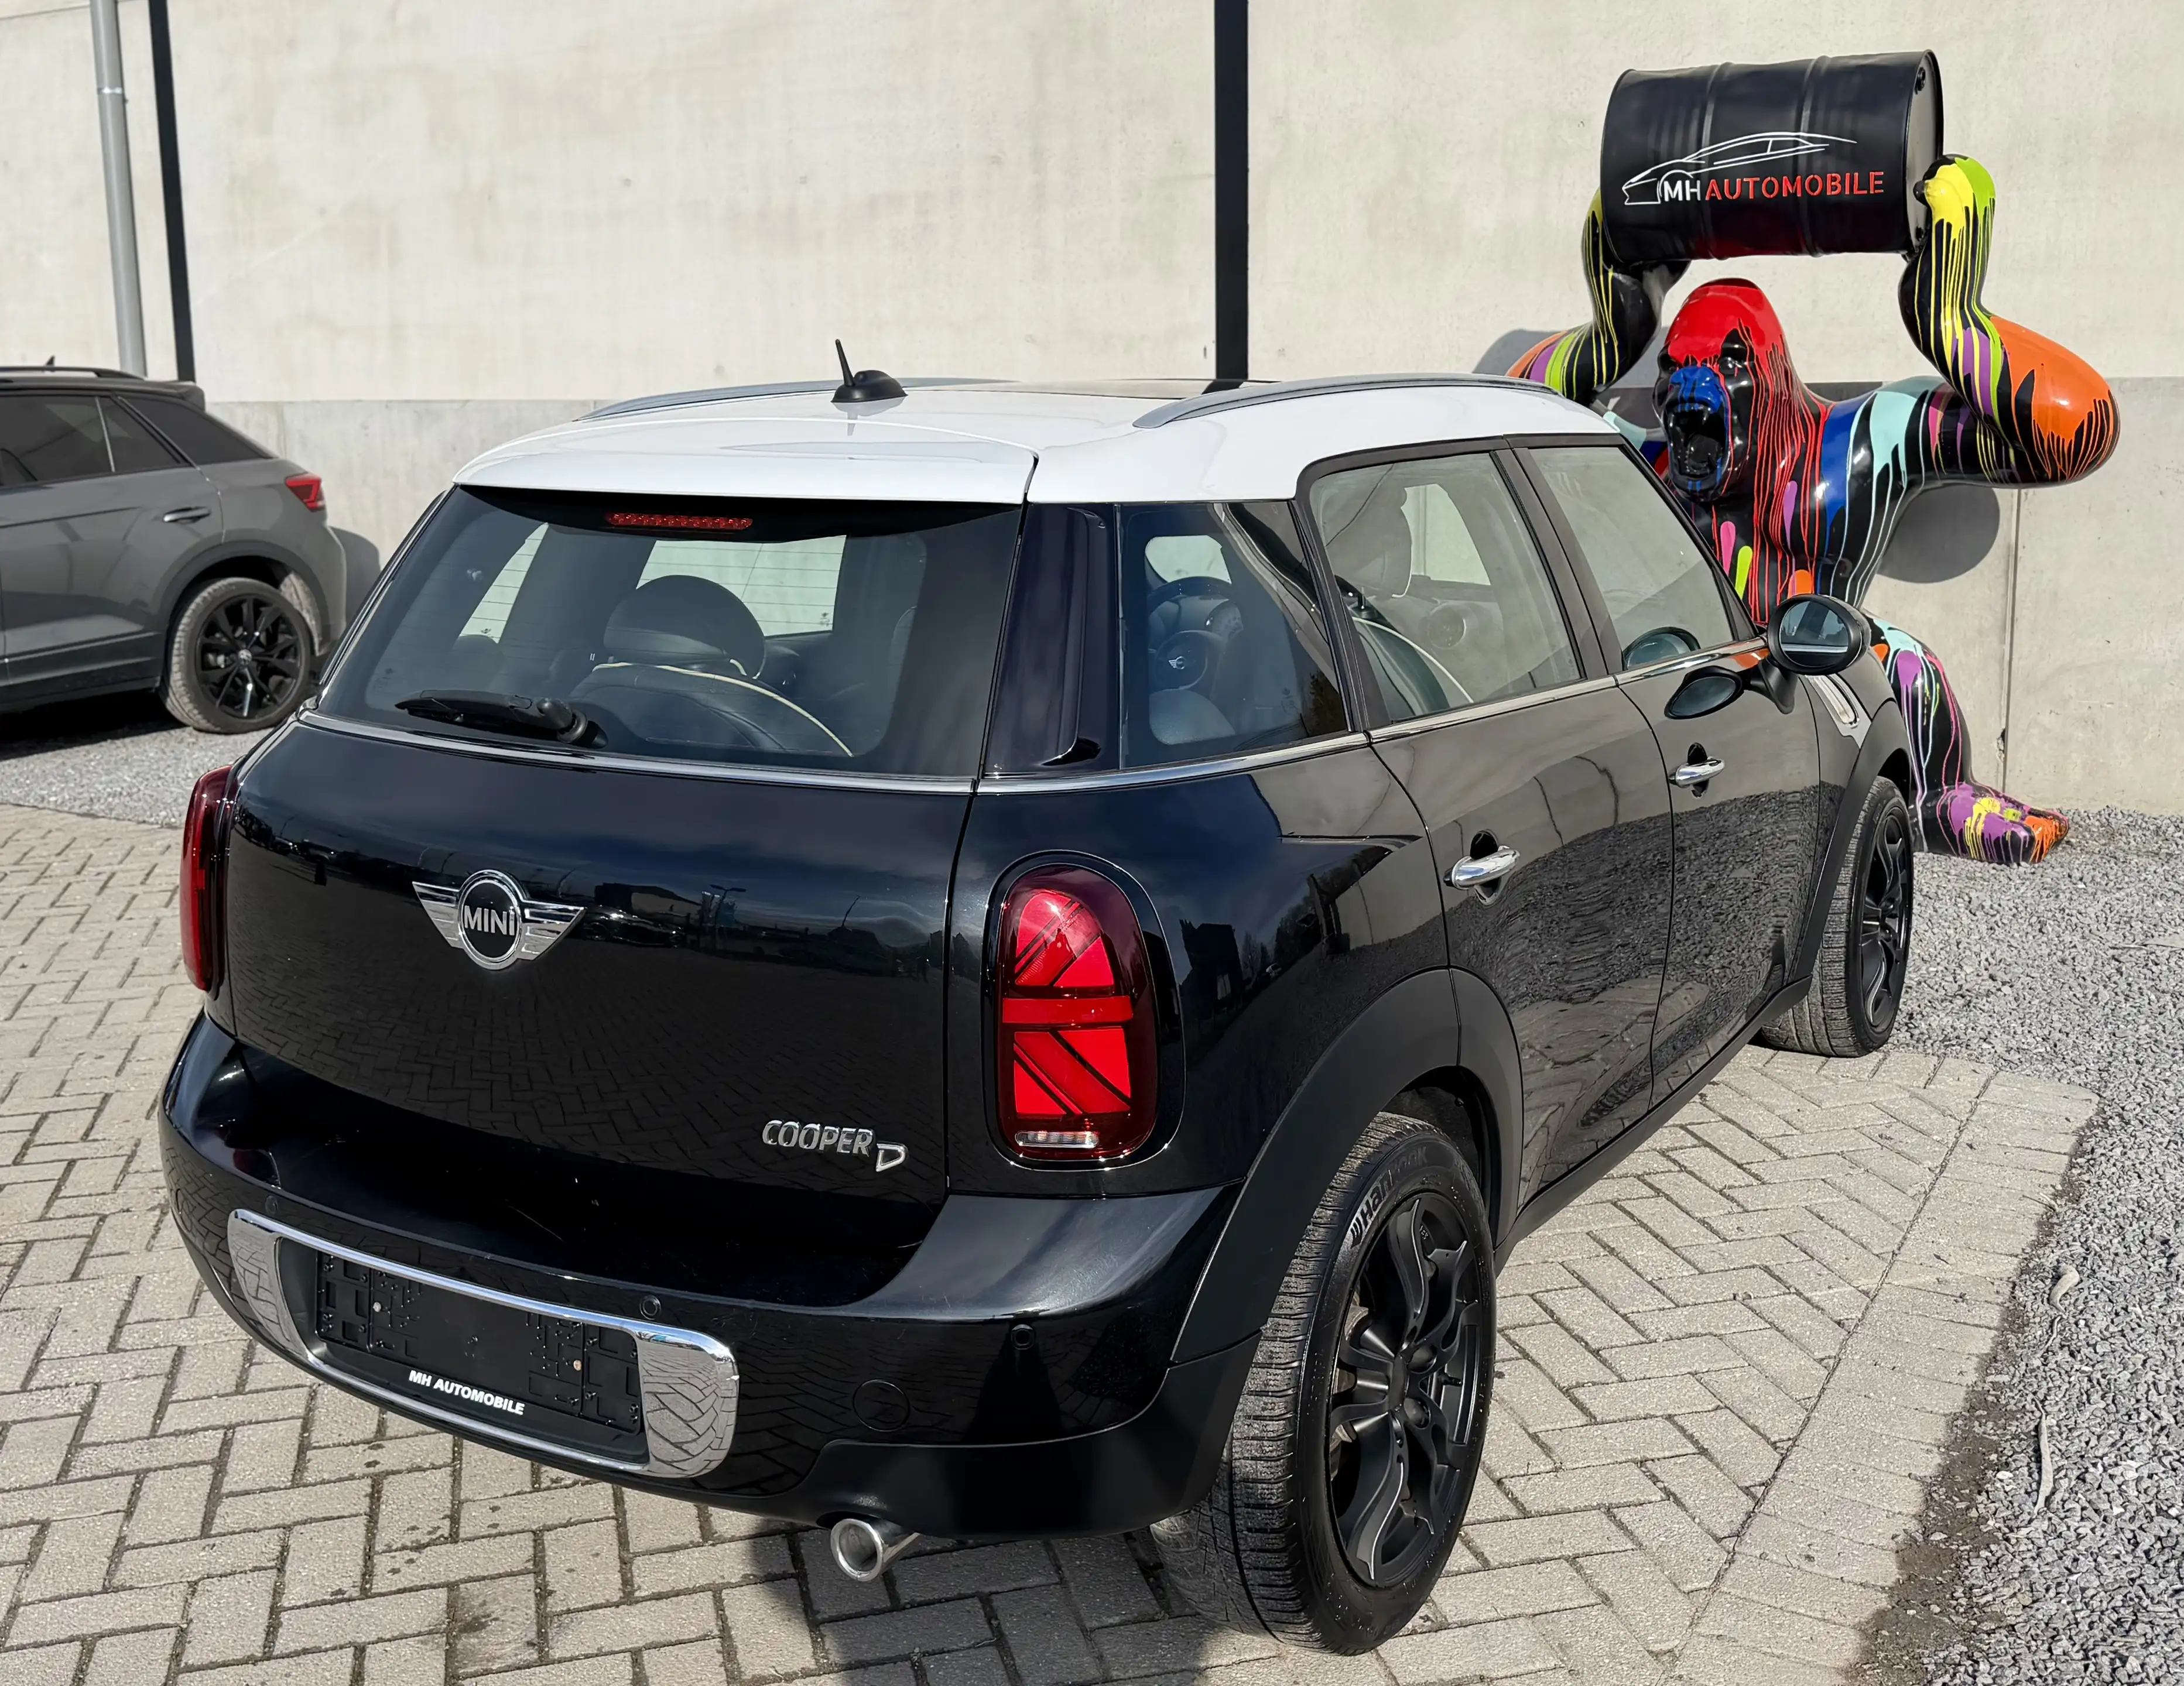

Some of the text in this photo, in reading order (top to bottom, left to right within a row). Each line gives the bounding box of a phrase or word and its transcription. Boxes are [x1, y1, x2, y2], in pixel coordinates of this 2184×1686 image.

[1663, 172, 1884, 201] MH AUTOMOBILE
[464, 905, 516, 937] MINI
[762, 1119, 908, 1172] COOPER D
[409, 1370, 525, 1416] MH AUTOMOBILE
